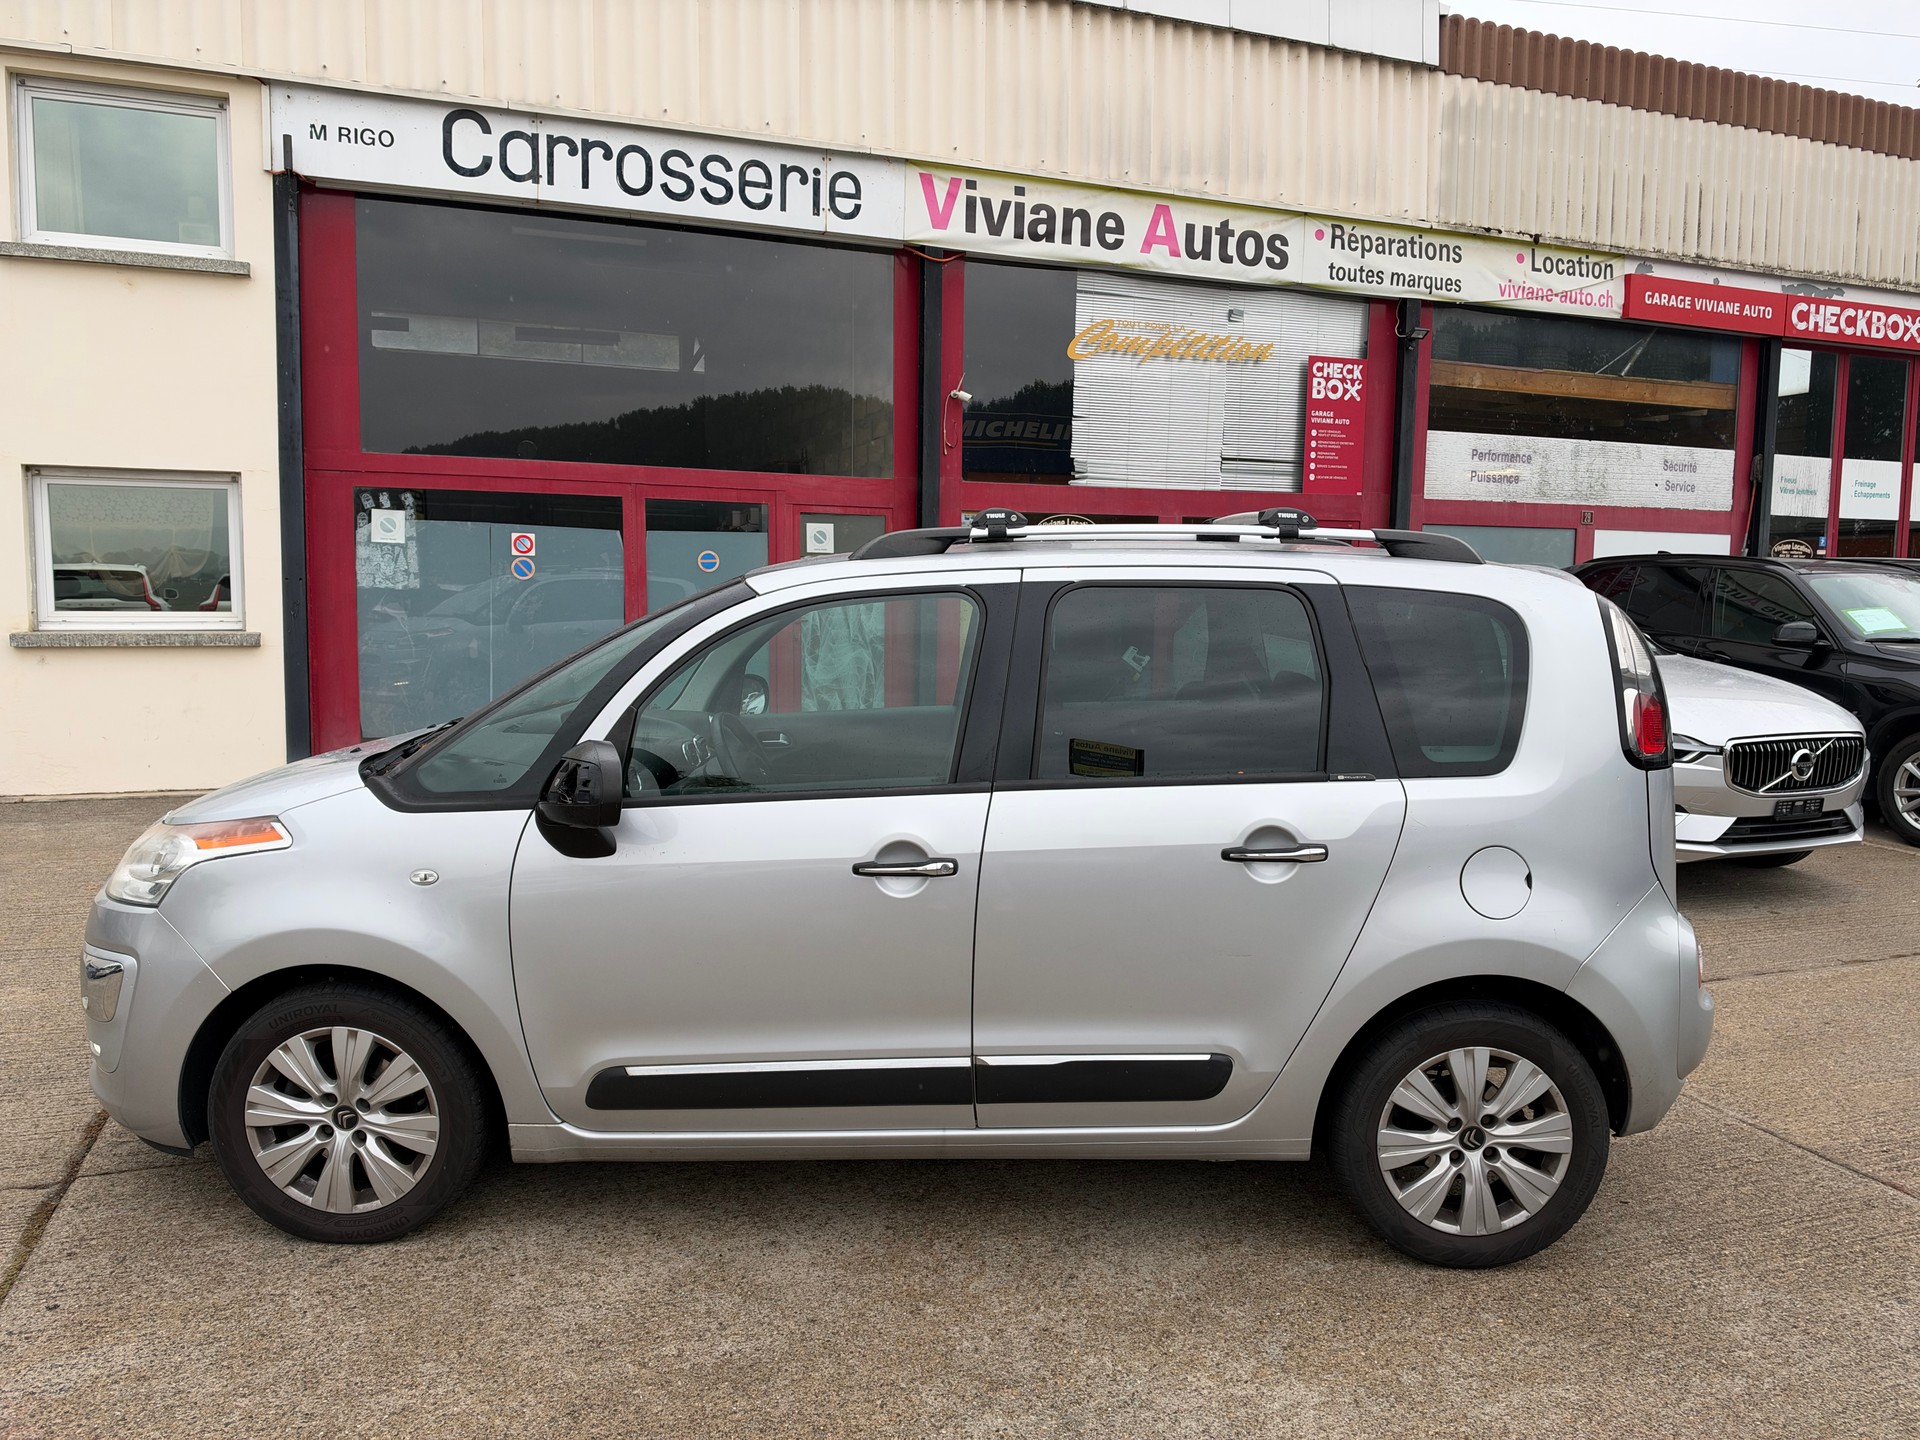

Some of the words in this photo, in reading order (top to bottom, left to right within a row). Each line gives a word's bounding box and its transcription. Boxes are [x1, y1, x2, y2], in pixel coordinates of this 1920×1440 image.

[309, 123, 329, 142] M
[338, 126, 395, 149] RIGO
[442, 109, 862, 221] Carrosserie
[918, 172, 1126, 254] Viviane
[1139, 203, 1290, 271] Autos
[1330, 224, 1463, 265] Réparations
[1531, 248, 1615, 281] Location
[1328, 262, 1385, 287] toutes
[1390, 269, 1462, 296] marques
[1499, 279, 1615, 310] viviane-auto.ch
[1645, 291, 1691, 309] GARAGE
[1694, 298, 1740, 316] VIVIANE
[1743, 305, 1773, 320] AUTO
[1791, 302, 1920, 344] CHECKBOX
[1067, 319, 1274, 364] Compétition
[1312, 361, 1363, 380] CHECK
[1312, 378, 1362, 401] BOX
[1311, 417, 1333, 425] VIVIANE
[1471, 449, 1532, 464] Performance
[1663, 459, 1697, 473] Sécurité
[1470, 471, 1520, 485] Puissance
[1665, 480, 1696, 493] Service
[1855, 480, 1876, 488] Freinage
[1854, 490, 1890, 499] Echappements
[986, 512, 1006, 520] THULE
[1277, 511, 1298, 520] THULE
[268, 1004, 343, 1030] UNIROYAL
